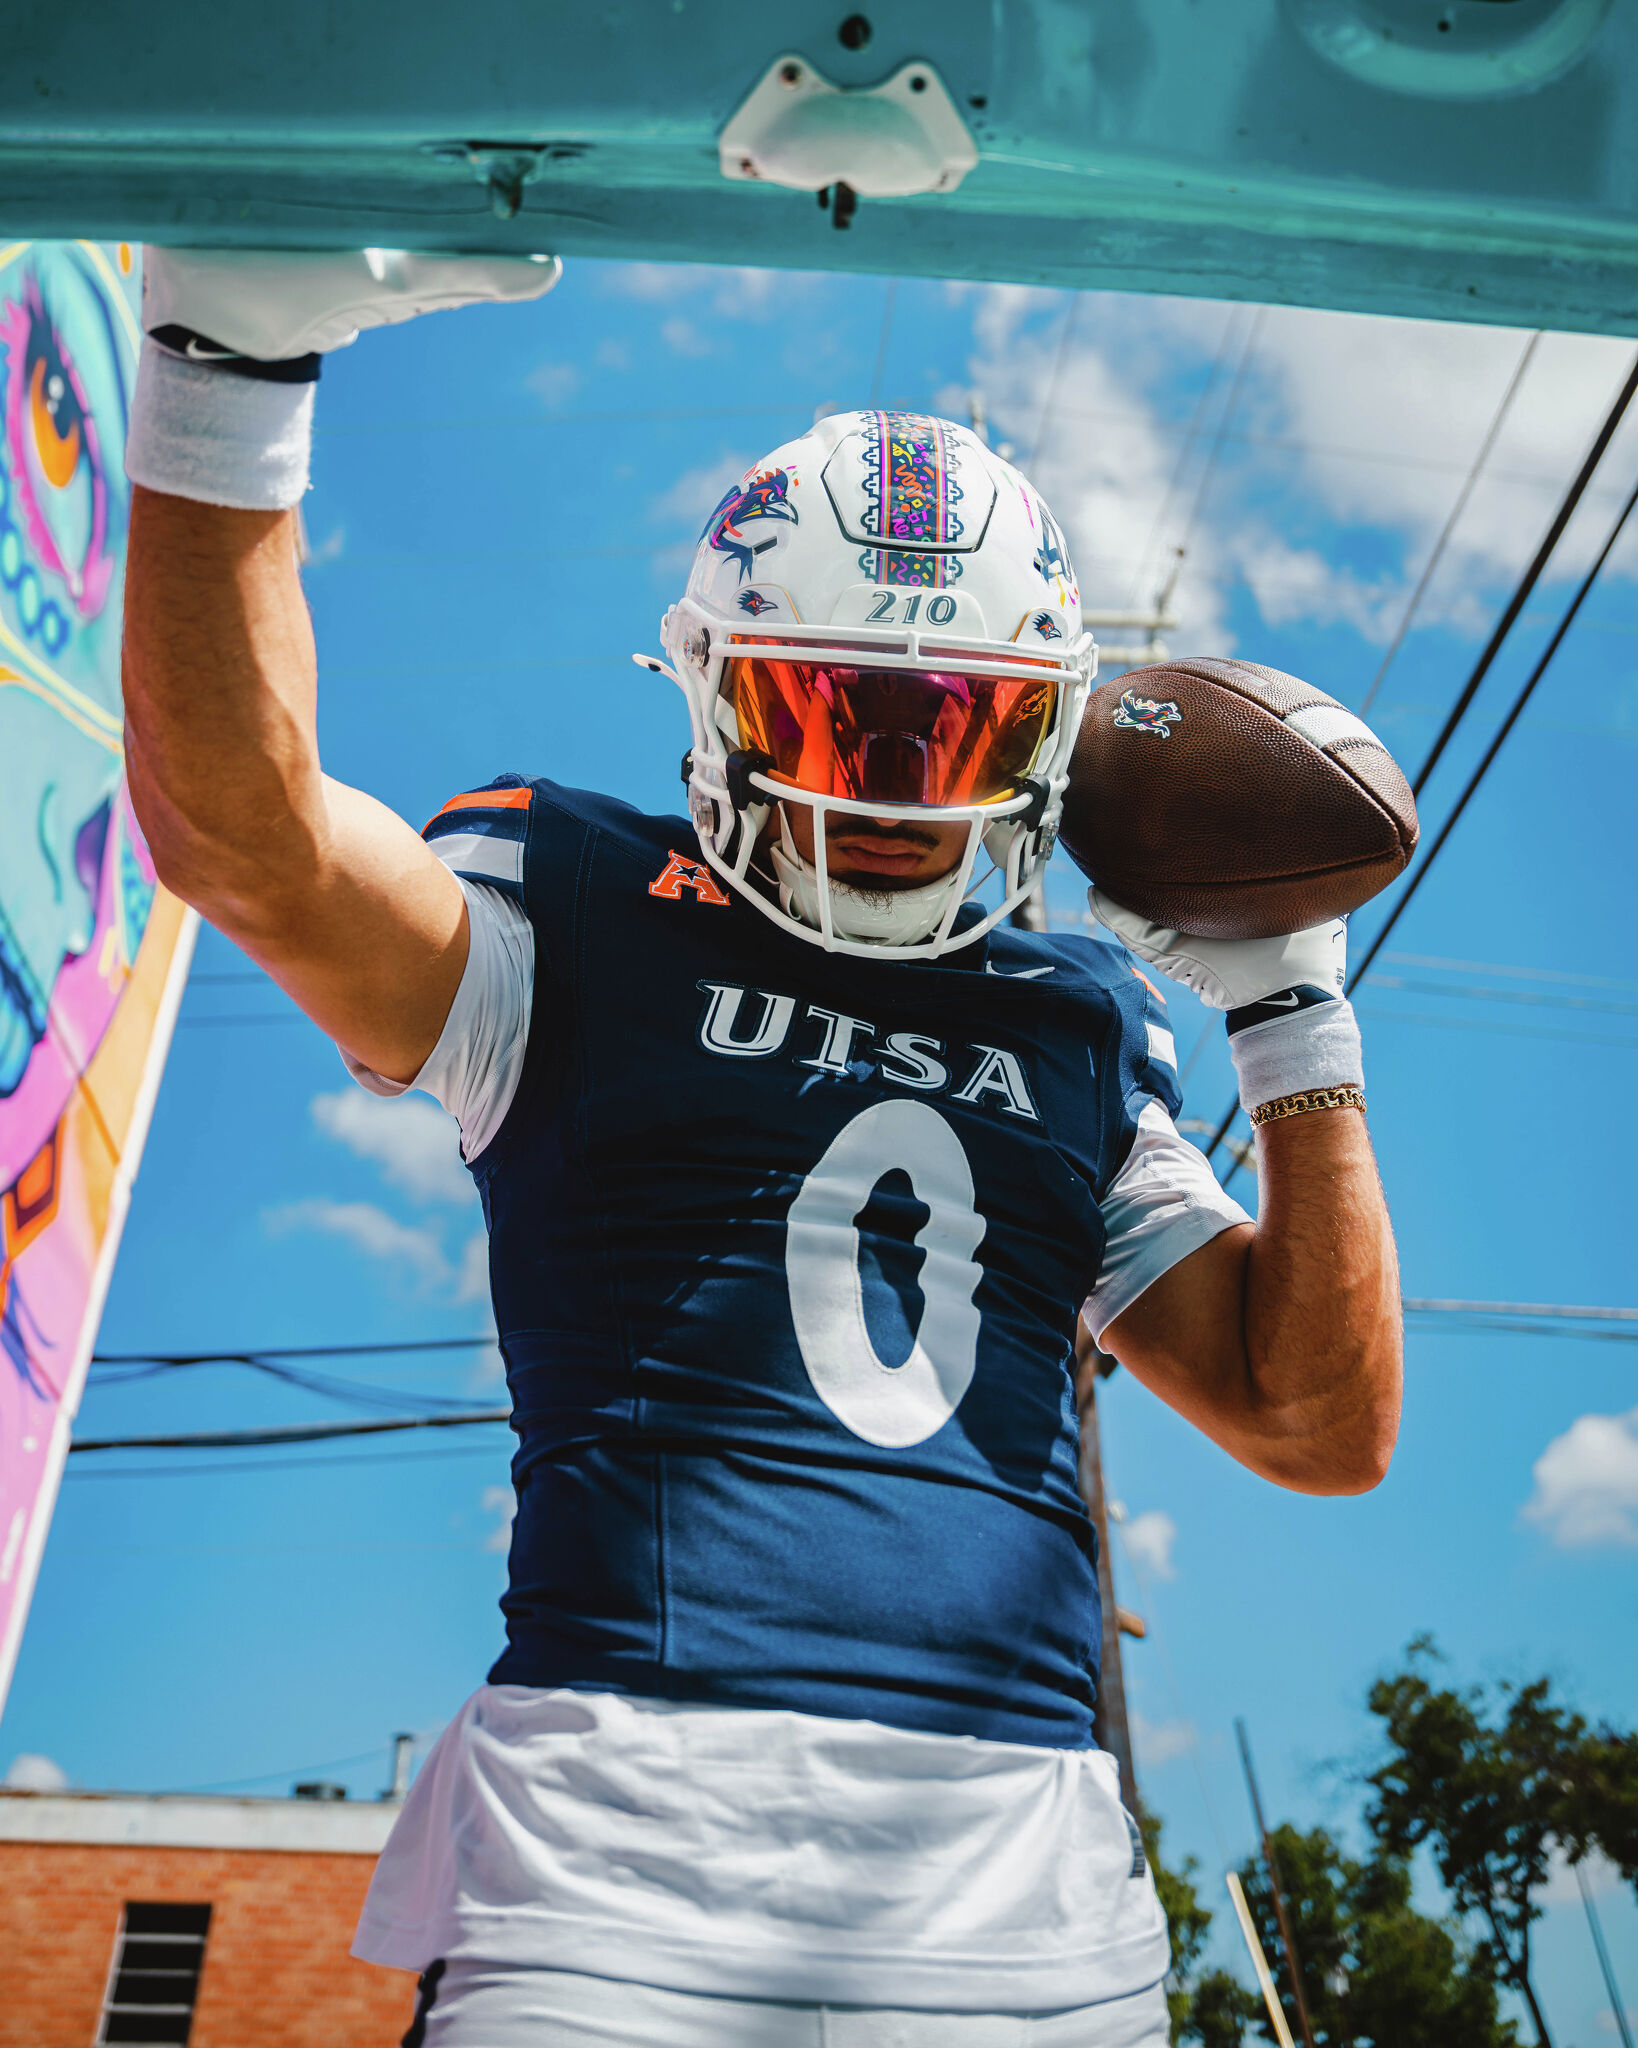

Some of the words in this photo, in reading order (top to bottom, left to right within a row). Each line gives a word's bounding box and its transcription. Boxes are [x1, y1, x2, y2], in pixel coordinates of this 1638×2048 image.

[865, 590, 957, 626] 210
[648, 848, 731, 906] A
[699, 981, 1042, 1123] UTSA
[786, 1098, 987, 1449] 0
